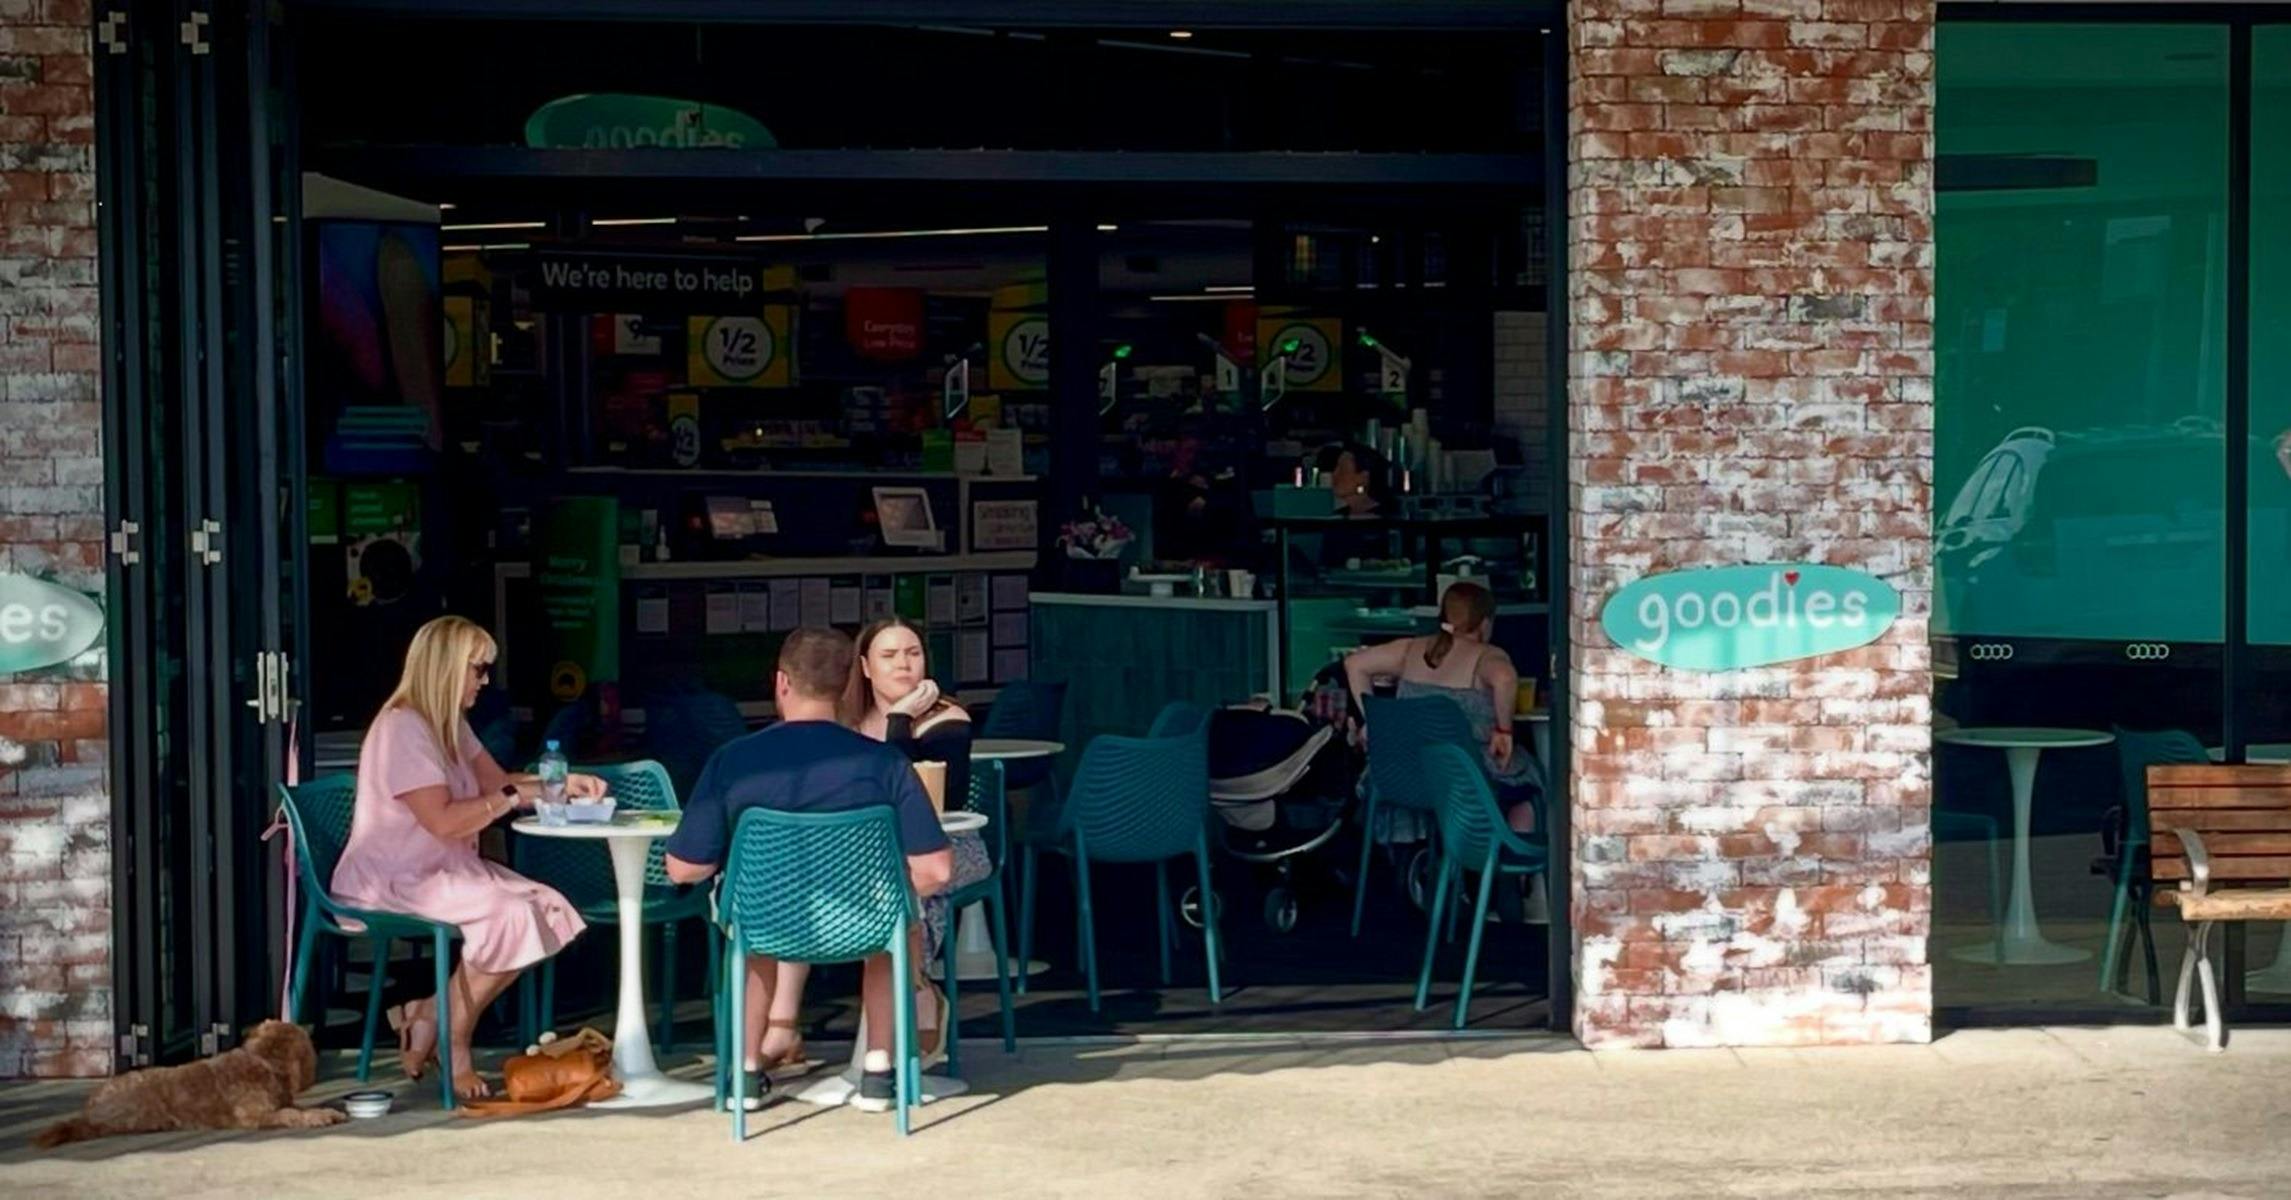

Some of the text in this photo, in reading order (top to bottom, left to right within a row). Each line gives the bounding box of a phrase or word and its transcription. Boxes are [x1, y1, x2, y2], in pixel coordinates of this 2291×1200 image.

[542, 262, 753, 300] We're here to help
[719, 327, 756, 353] 1/2
[1388, 371, 1401, 388] 2
[1634, 571, 1869, 651] goodies
